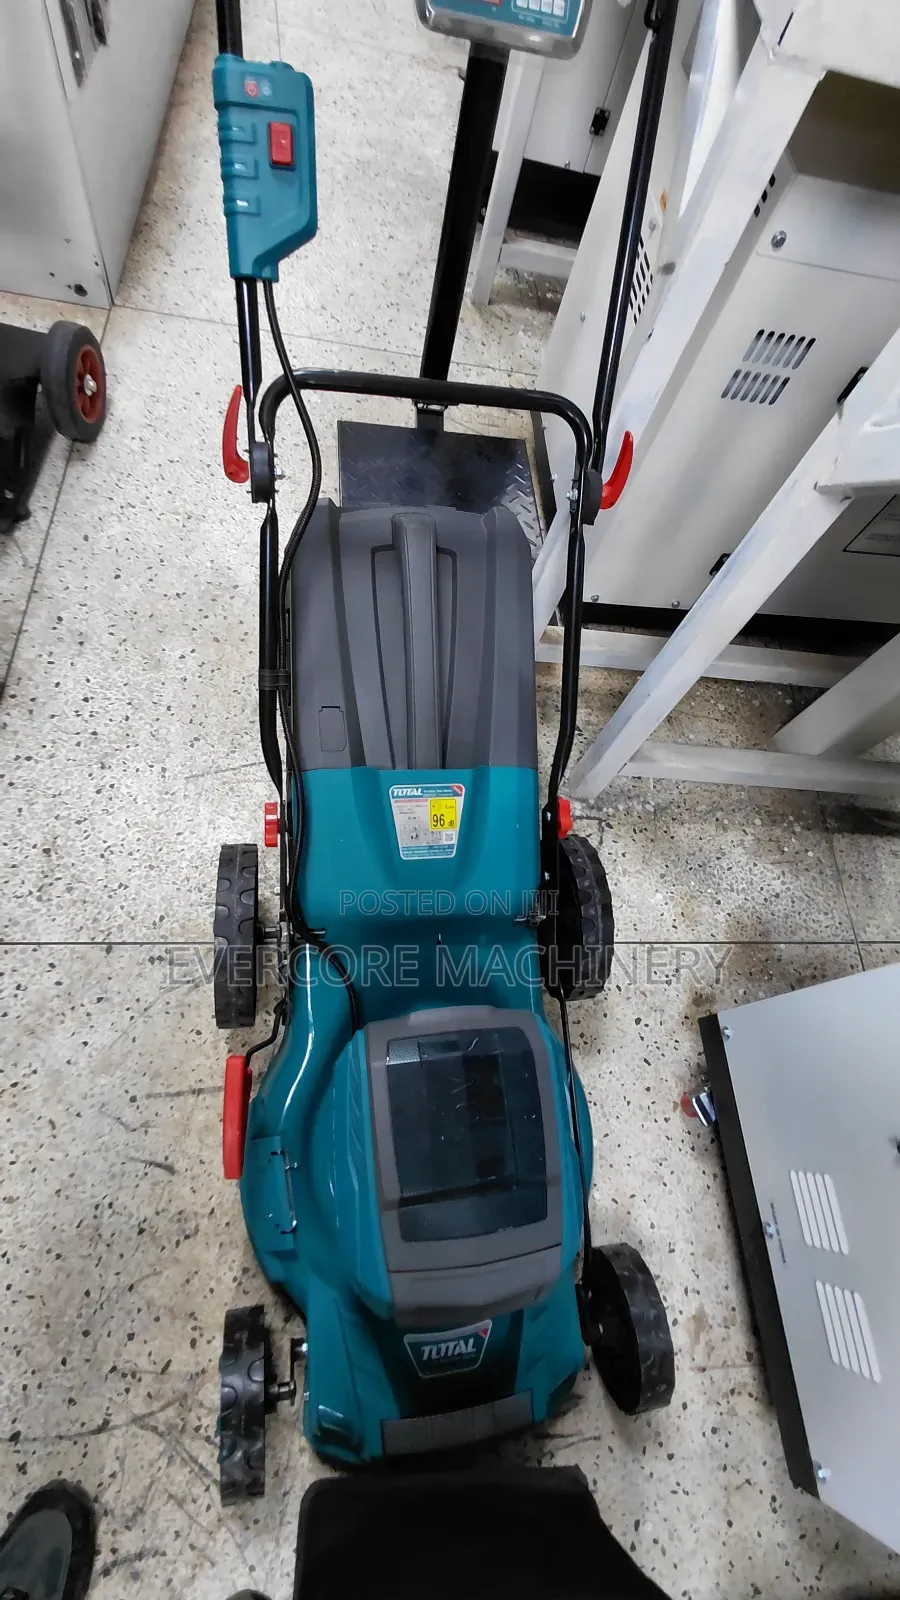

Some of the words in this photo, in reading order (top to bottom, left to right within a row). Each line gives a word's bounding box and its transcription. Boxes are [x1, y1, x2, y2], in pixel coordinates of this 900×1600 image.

[393, 788, 423, 797] TOTAL
[432, 813, 445, 828] 96
[421, 1338, 476, 1360] TOTAL
